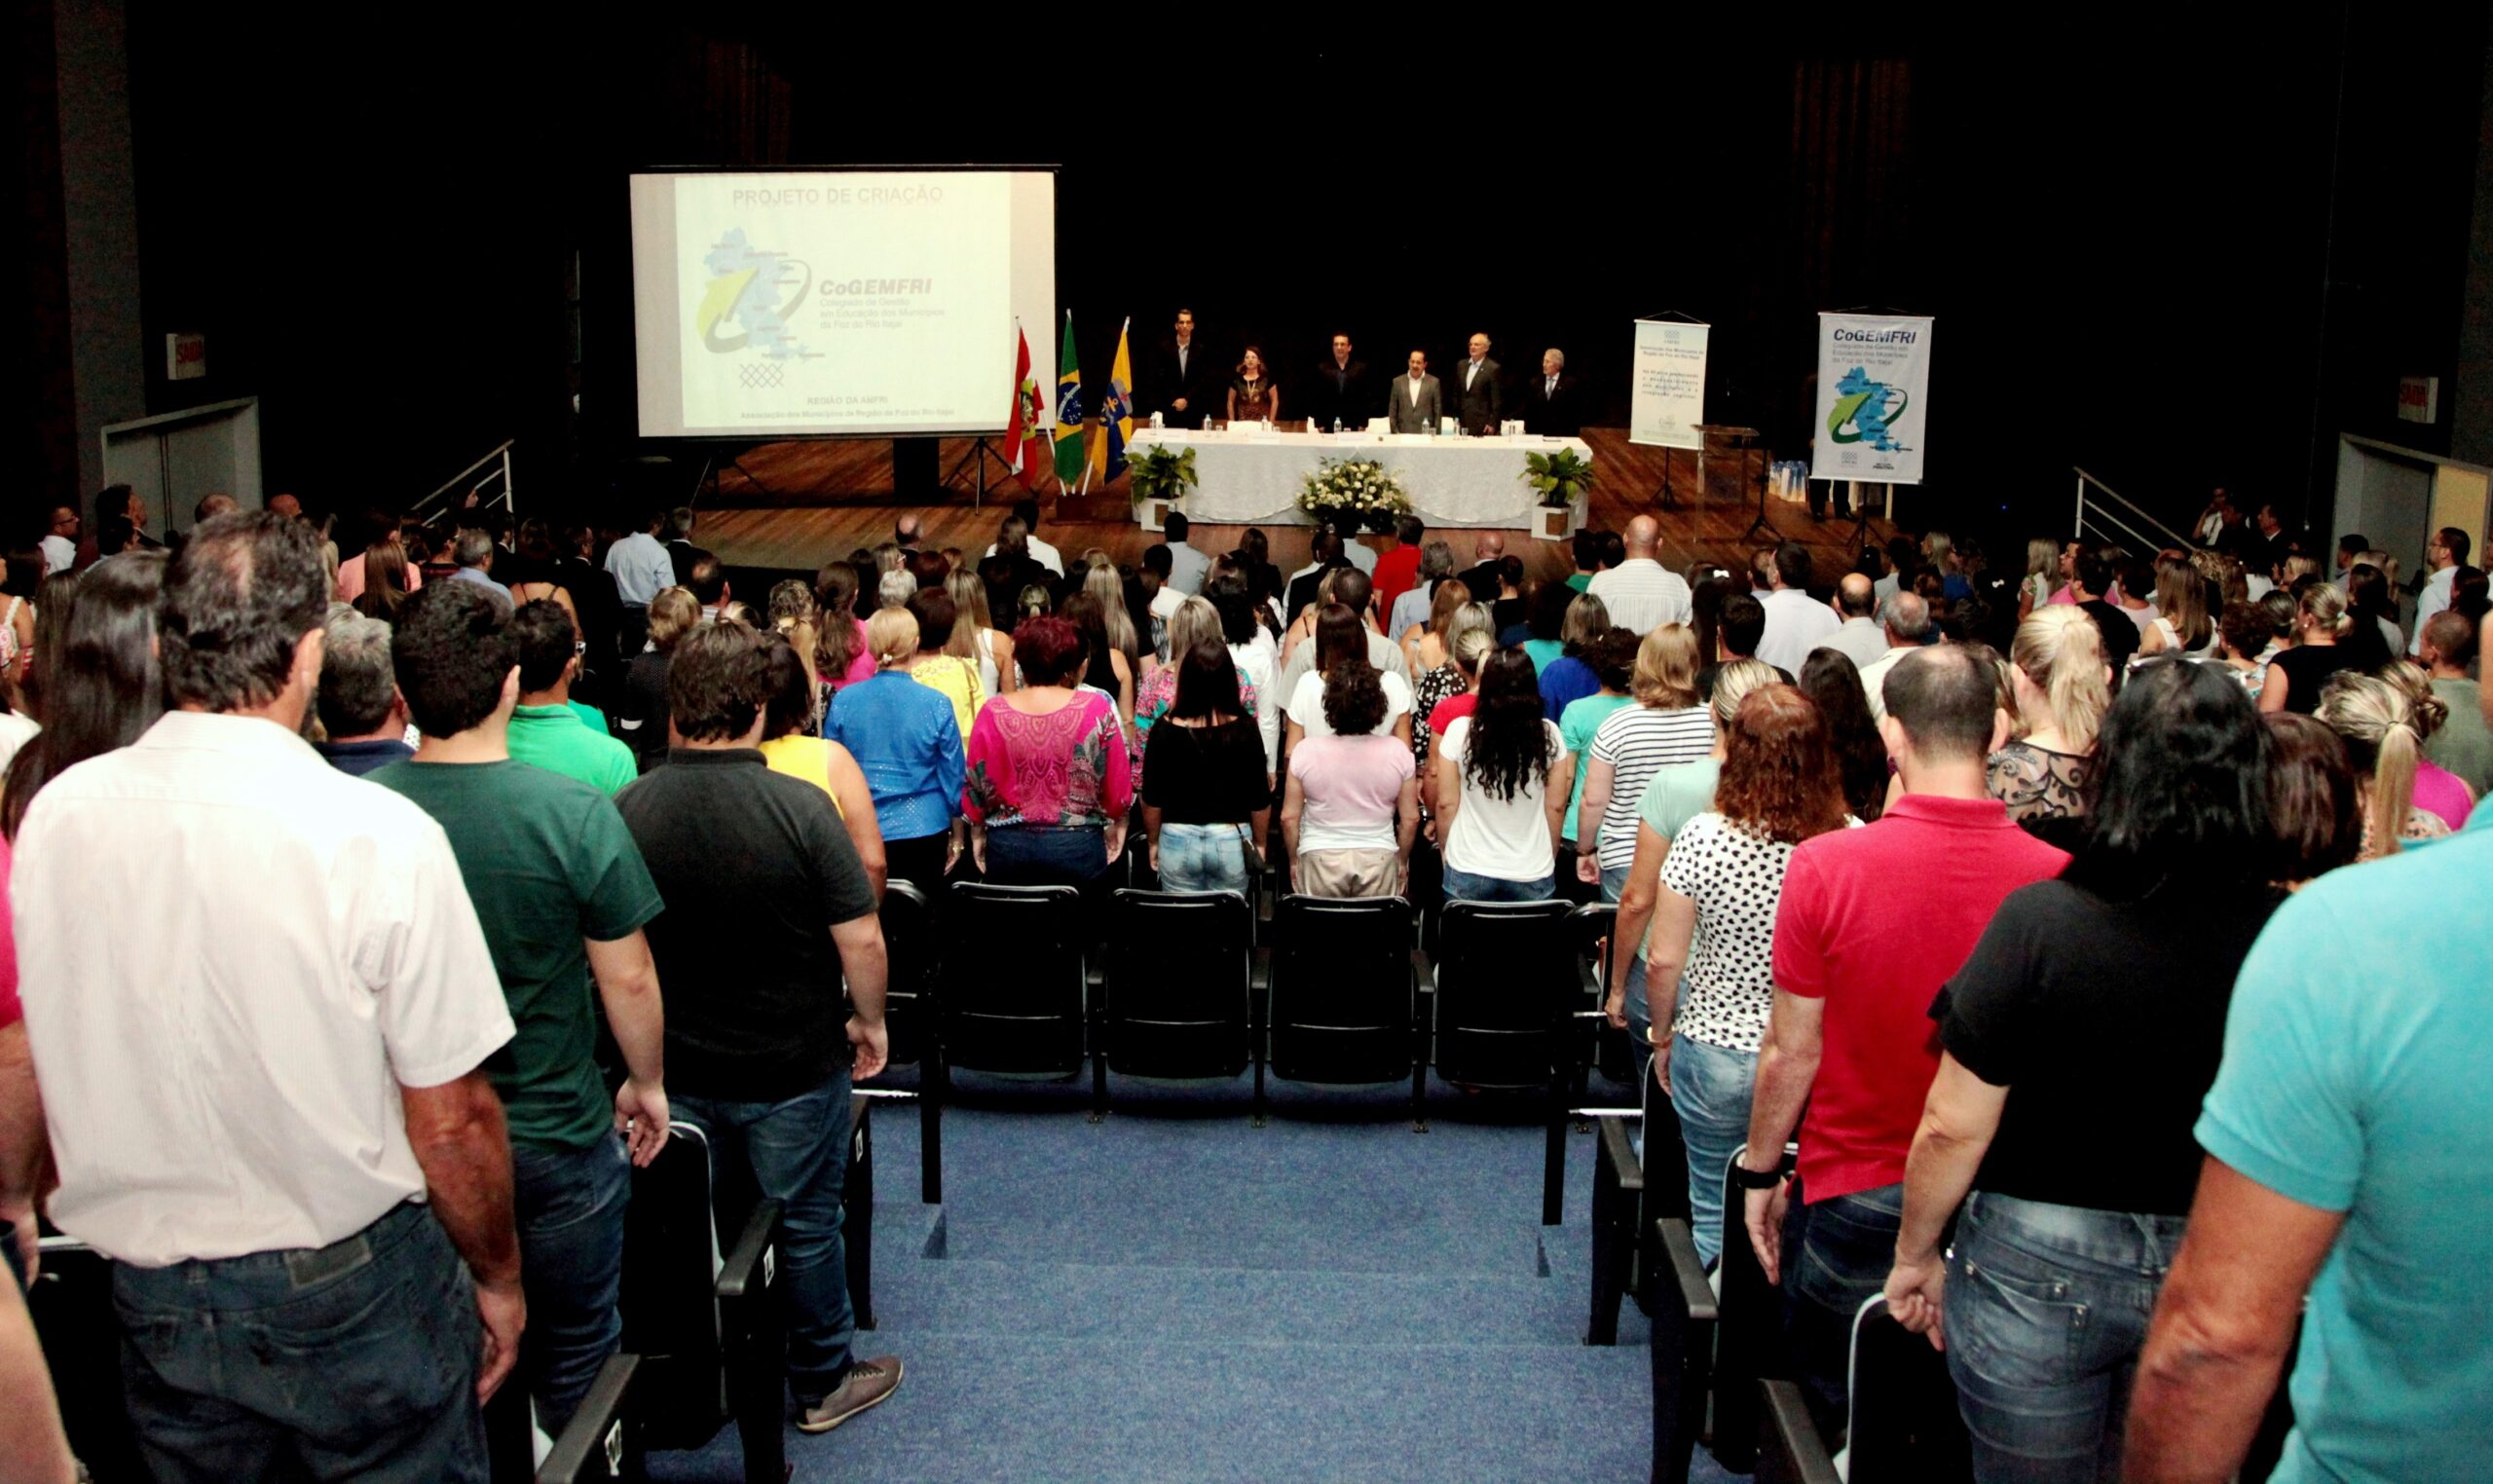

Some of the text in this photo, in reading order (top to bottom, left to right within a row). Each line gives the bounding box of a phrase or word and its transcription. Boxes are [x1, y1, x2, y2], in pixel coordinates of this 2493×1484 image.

[732, 184, 944, 204] PROJETO DE CRIAÇÃO
[819, 278, 933, 296] CoGEMFRI
[836, 308, 879, 318] Educação
[1834, 328, 1916, 344] CoGEMFRI
[807, 394, 842, 405] REGIÃO
